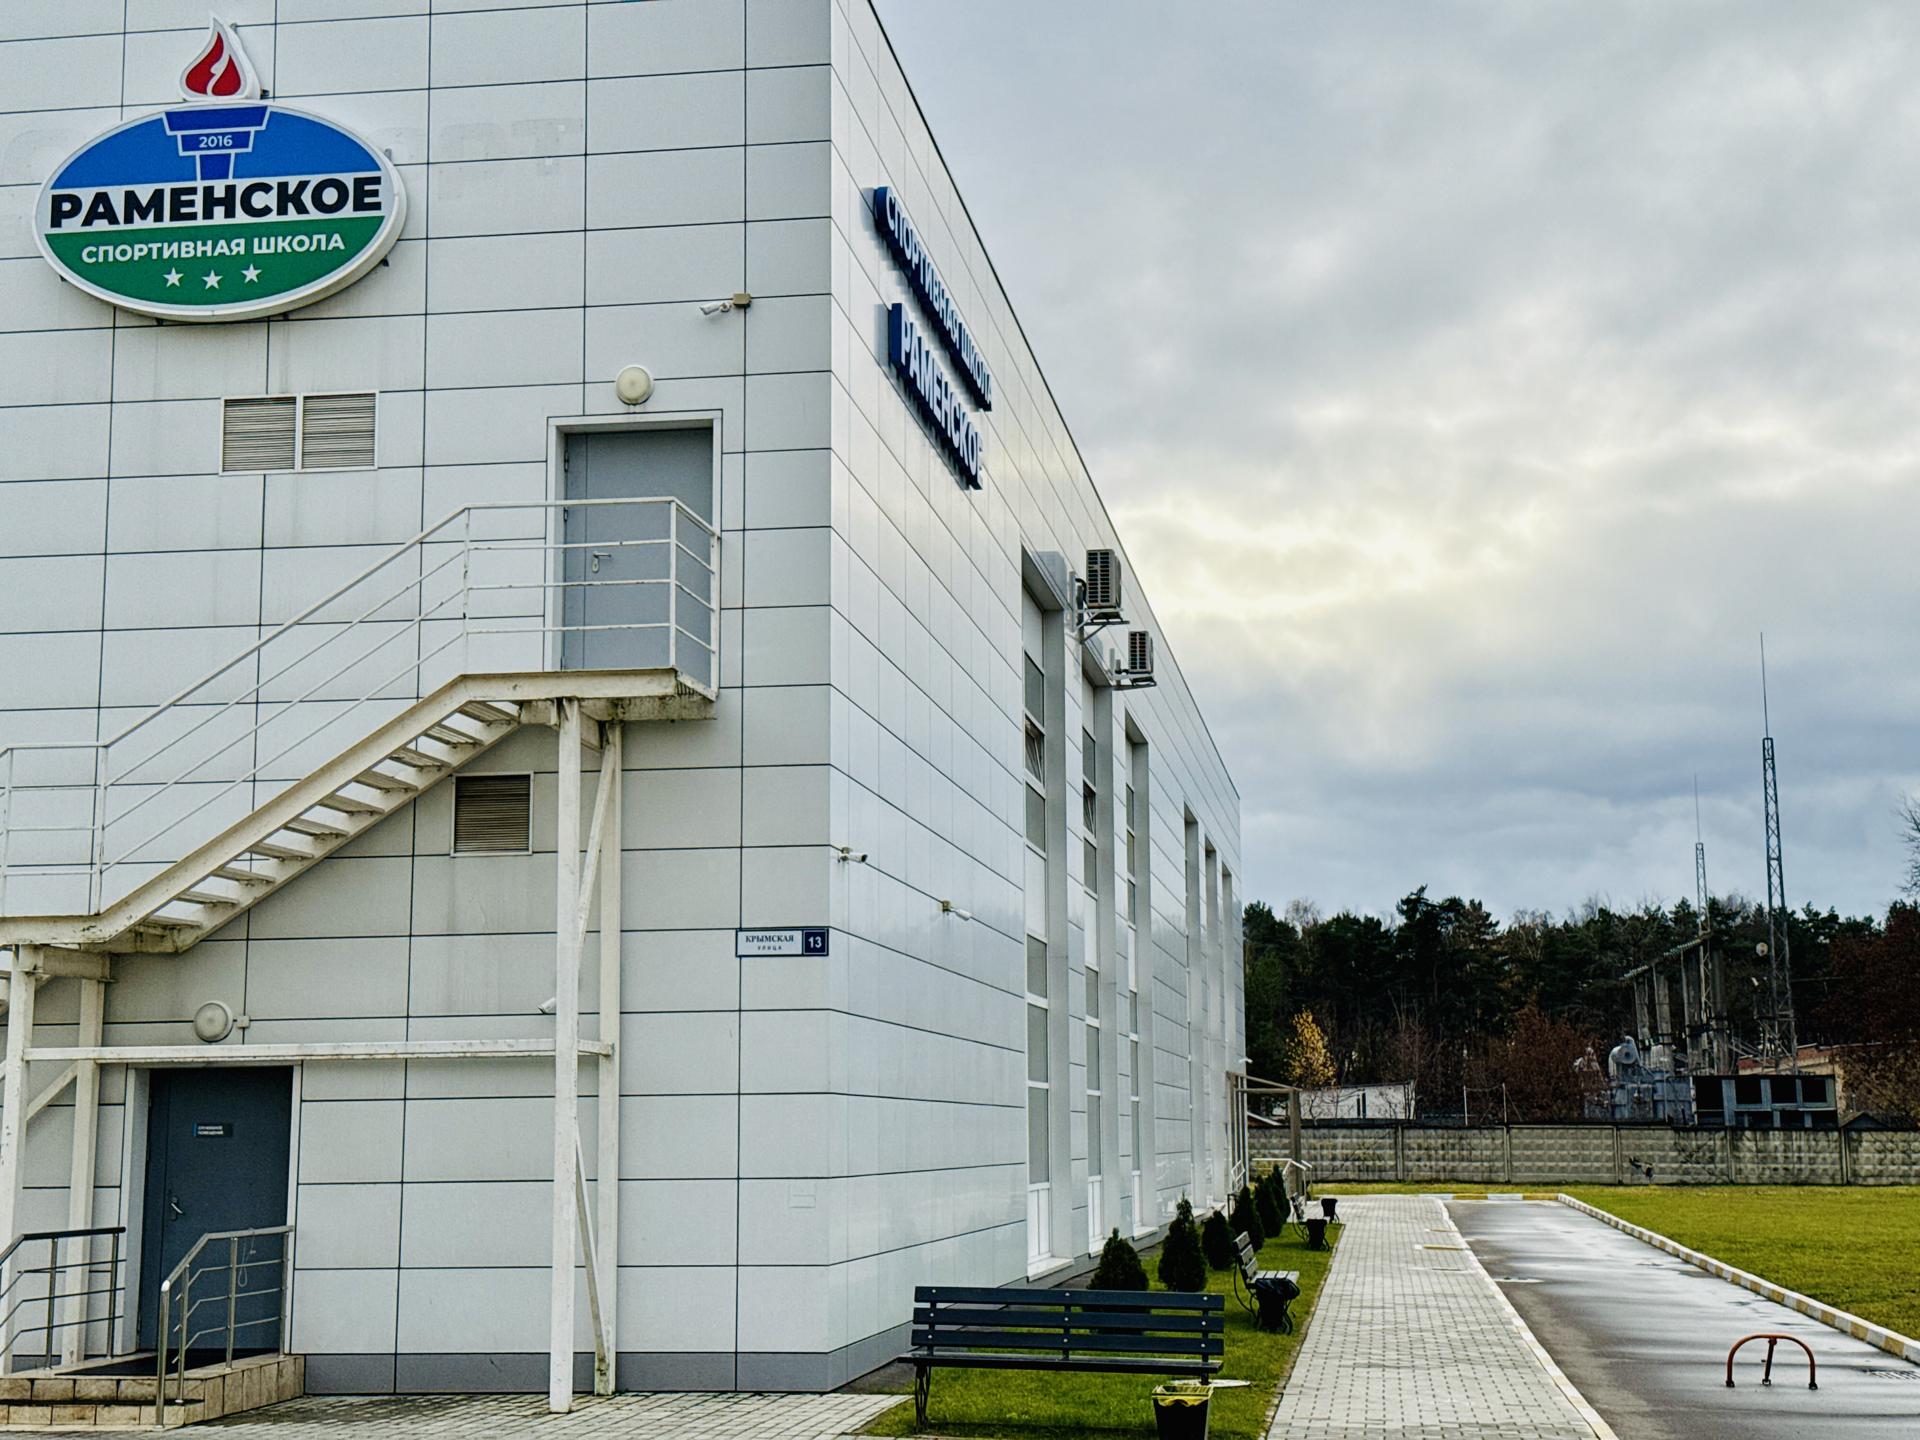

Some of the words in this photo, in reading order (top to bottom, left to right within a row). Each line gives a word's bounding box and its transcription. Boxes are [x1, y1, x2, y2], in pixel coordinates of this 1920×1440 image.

[198, 135, 233, 148] 2016
[50, 176, 382, 229] РАМЕНСКОЕ
[81, 238, 245, 264] СПОРТИВНАЯ
[253, 232, 345, 255] ШКОЛА
[885, 187, 960, 350] СПОРТИВНАЯ
[961, 322, 992, 405] ШКОЛА
[900, 303, 983, 487] РАМЕНСКОЕ
[745, 934, 794, 943] КРЫМСКАЯ
[808, 936, 822, 948] 13
